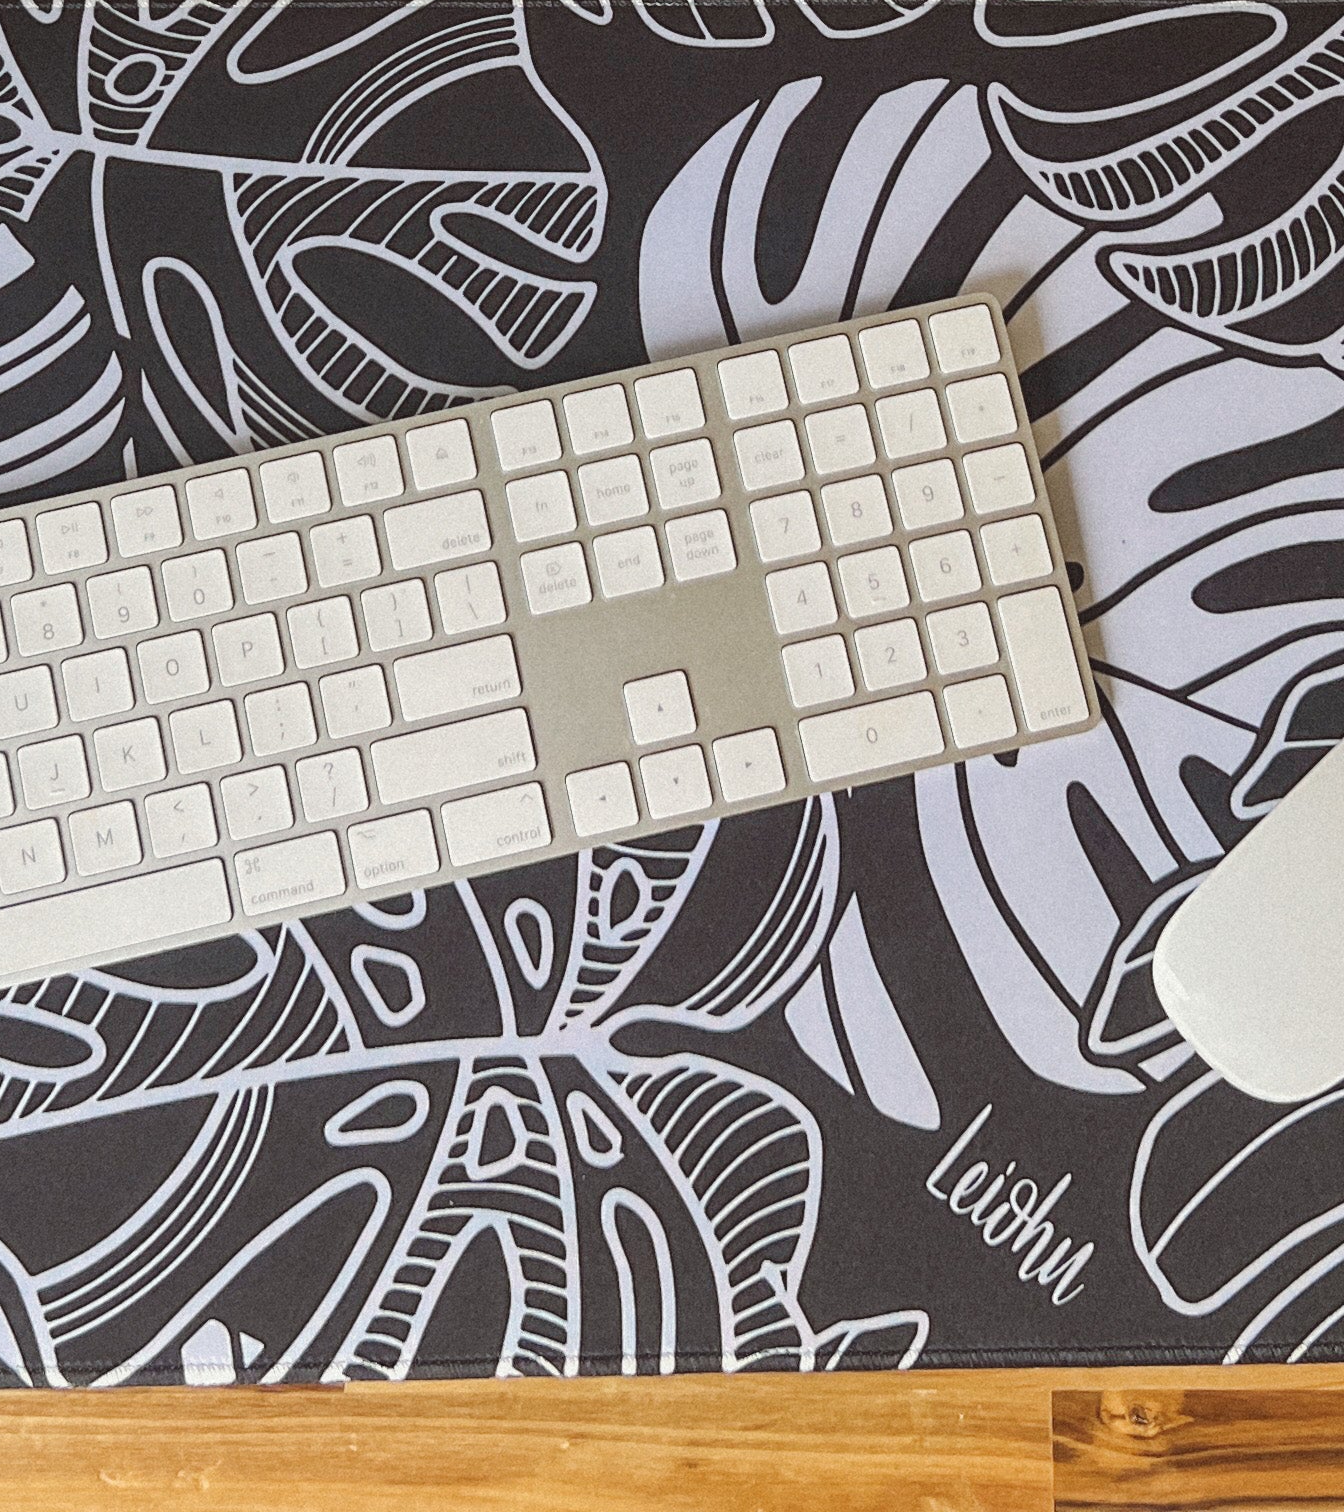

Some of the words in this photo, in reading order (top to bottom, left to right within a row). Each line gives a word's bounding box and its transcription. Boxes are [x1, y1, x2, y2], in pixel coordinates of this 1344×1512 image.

[753, 448, 784, 464] clear
[668, 459, 699, 477] page
[595, 483, 631, 500] home
[678, 476, 696, 489] up
[921, 485, 935, 503] 9
[534, 500, 549, 513] fn
[849, 501, 864, 519] 8
[778, 516, 791, 535] 7
[441, 533, 481, 551] delete
[683, 529, 715, 546] page
[616, 554, 642, 570] end
[685, 545, 720, 562] down
[938, 557, 953, 575] 6
[537, 578, 577, 596] delete
[867, 572, 881, 591] 5
[192, 587, 206, 606] 0
[796, 589, 808, 606] 4
[116, 605, 131, 624] 9
[41, 622, 56, 641] 8
[956, 629, 970, 648] 3
[240, 640, 254, 659] P
[884, 645, 897, 665] 2
[164, 657, 181, 677] O
[814, 662, 824, 679] 1
[94, 676, 101, 694] I
[471, 678, 512, 696] return
[13, 692, 29, 713] U
[1039, 705, 1072, 721] enter
[198, 729, 212, 747] L
[865, 726, 879, 745] 0
[121, 745, 135, 764] K
[497, 751, 527, 768] shift
[49, 762, 60, 782] J
[95, 828, 114, 848] M
[495, 825, 542, 848] control
[20, 846, 37, 866] N
[363, 859, 406, 879] option
[250, 879, 315, 906] command
